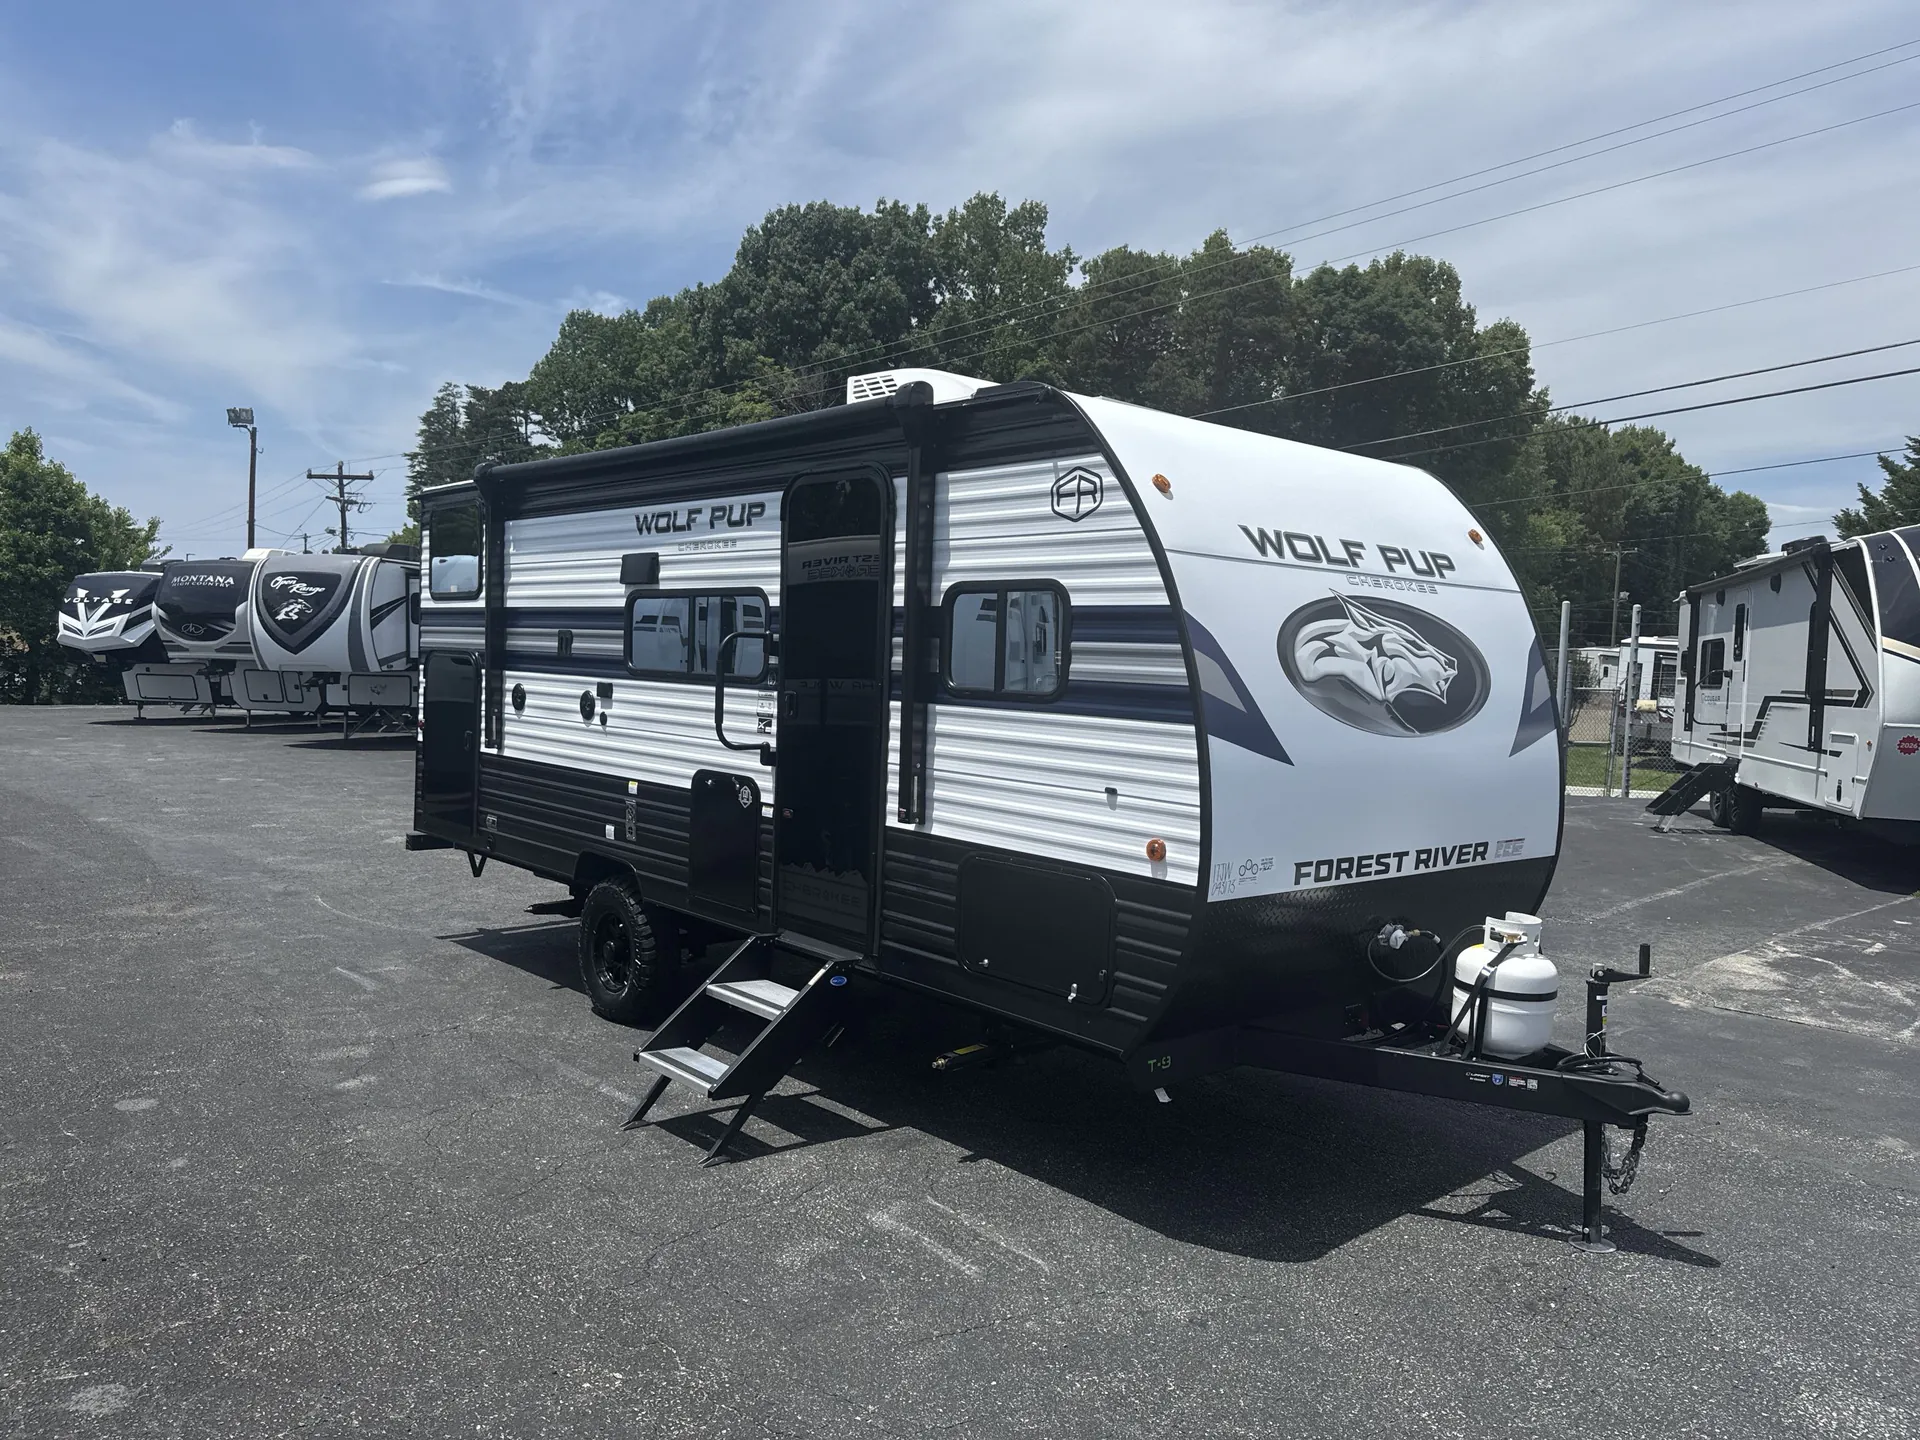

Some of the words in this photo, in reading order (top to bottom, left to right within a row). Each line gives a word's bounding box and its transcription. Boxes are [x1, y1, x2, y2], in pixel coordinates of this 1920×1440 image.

[635, 508, 702, 535] WOLF
[709, 501, 766, 529] PUP
[678, 539, 737, 551] CHEROKEE
[1237, 524, 1366, 568] WOLF
[1376, 544, 1456, 579] PUP
[171, 574, 235, 585] MONTANA
[270, 576, 298, 590] Open
[1346, 574, 1439, 595] CHEROKEE
[287, 582, 326, 596] Range
[63, 596, 134, 605] VOLTAGE
[1294, 850, 1410, 886] FOREST
[1414, 841, 1489, 870] RIVER
